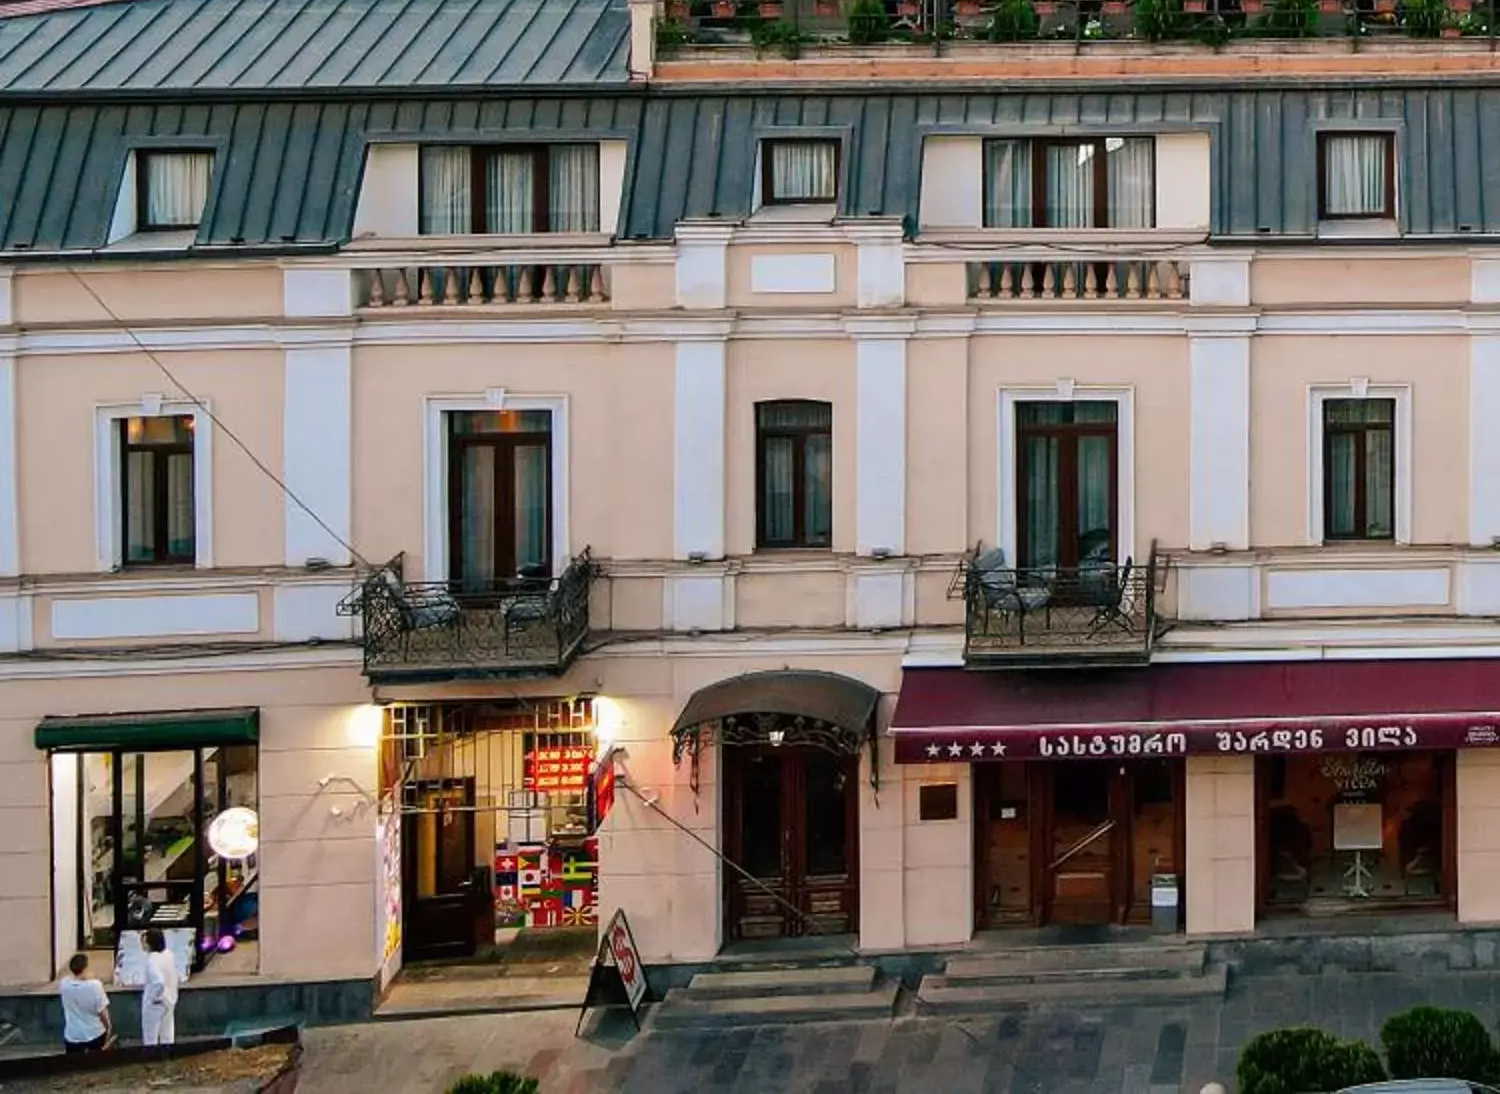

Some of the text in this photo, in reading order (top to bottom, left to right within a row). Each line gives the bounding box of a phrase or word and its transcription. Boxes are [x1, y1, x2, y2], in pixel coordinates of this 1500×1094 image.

[1038, 726, 1417, 756] სასტუმრო შარდენ ვილა
